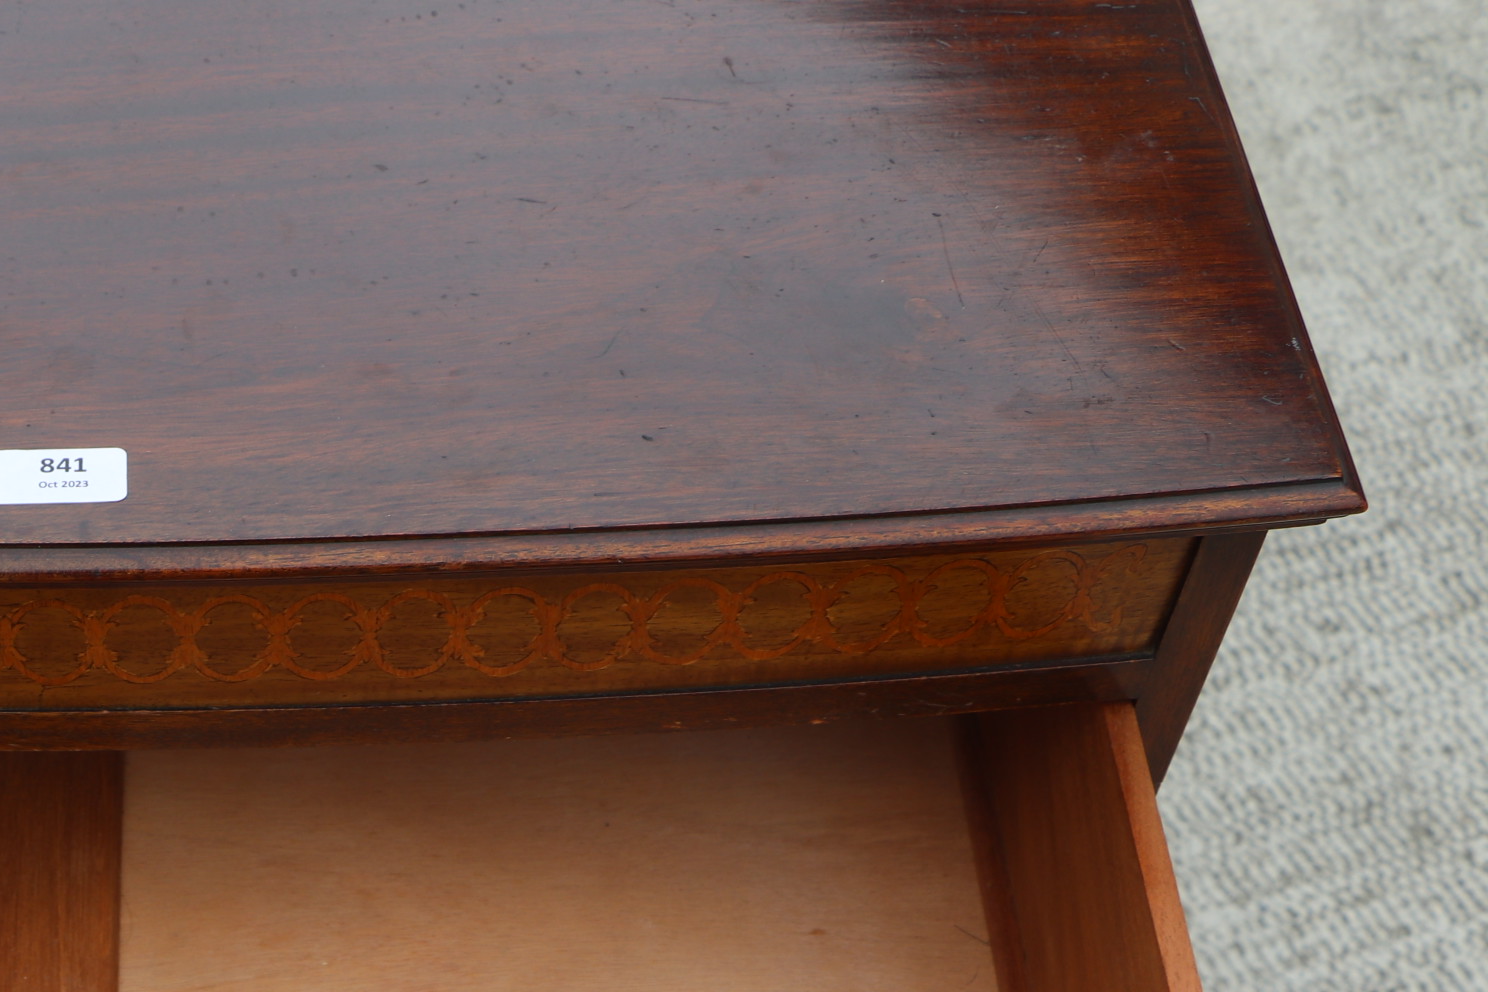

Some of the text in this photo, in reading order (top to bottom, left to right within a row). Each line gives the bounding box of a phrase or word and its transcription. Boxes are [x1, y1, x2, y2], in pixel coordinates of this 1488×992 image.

[40, 457, 87, 473] 841
[38, 480, 89, 489] Oct 2023
